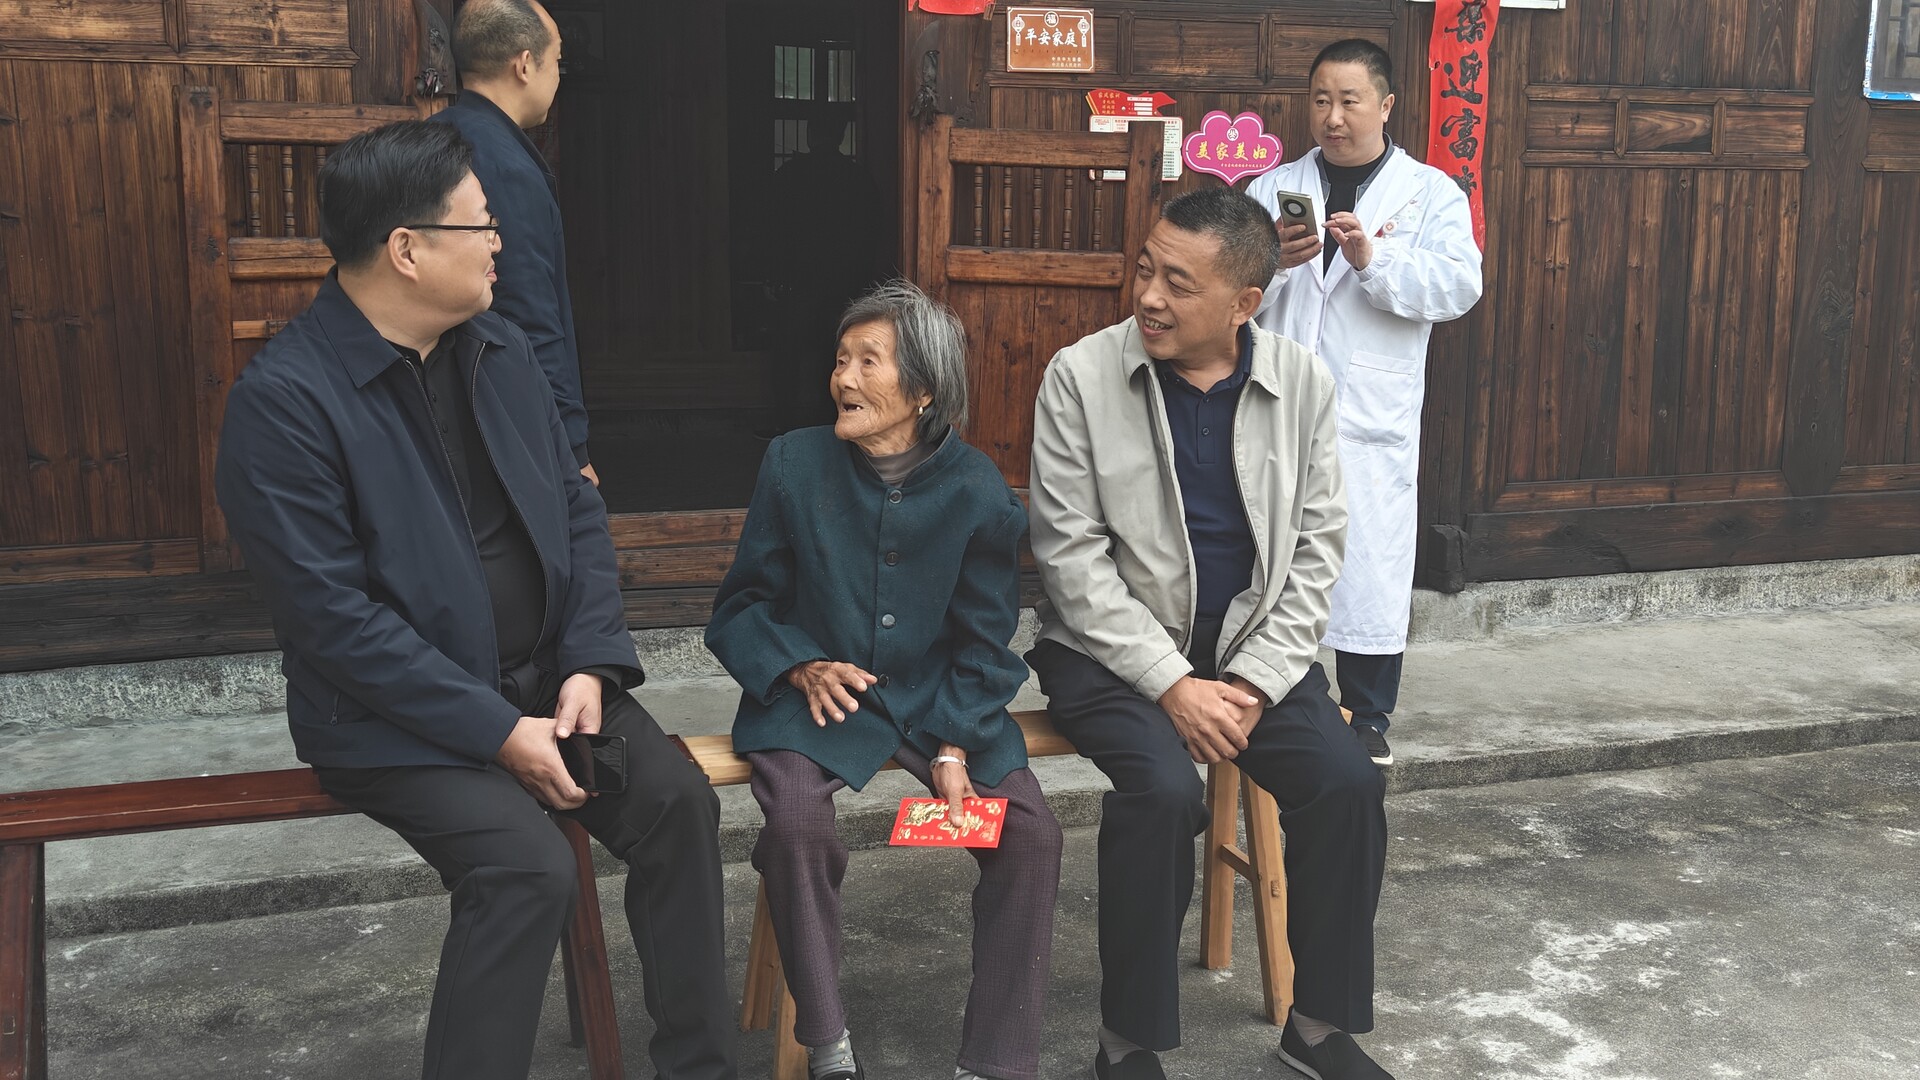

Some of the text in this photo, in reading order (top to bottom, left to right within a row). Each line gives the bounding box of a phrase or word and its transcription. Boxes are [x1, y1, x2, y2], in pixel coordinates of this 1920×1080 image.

[1025, 28, 1078, 48] 平安家庭
[1195, 141, 1268, 161] 美家美妇
